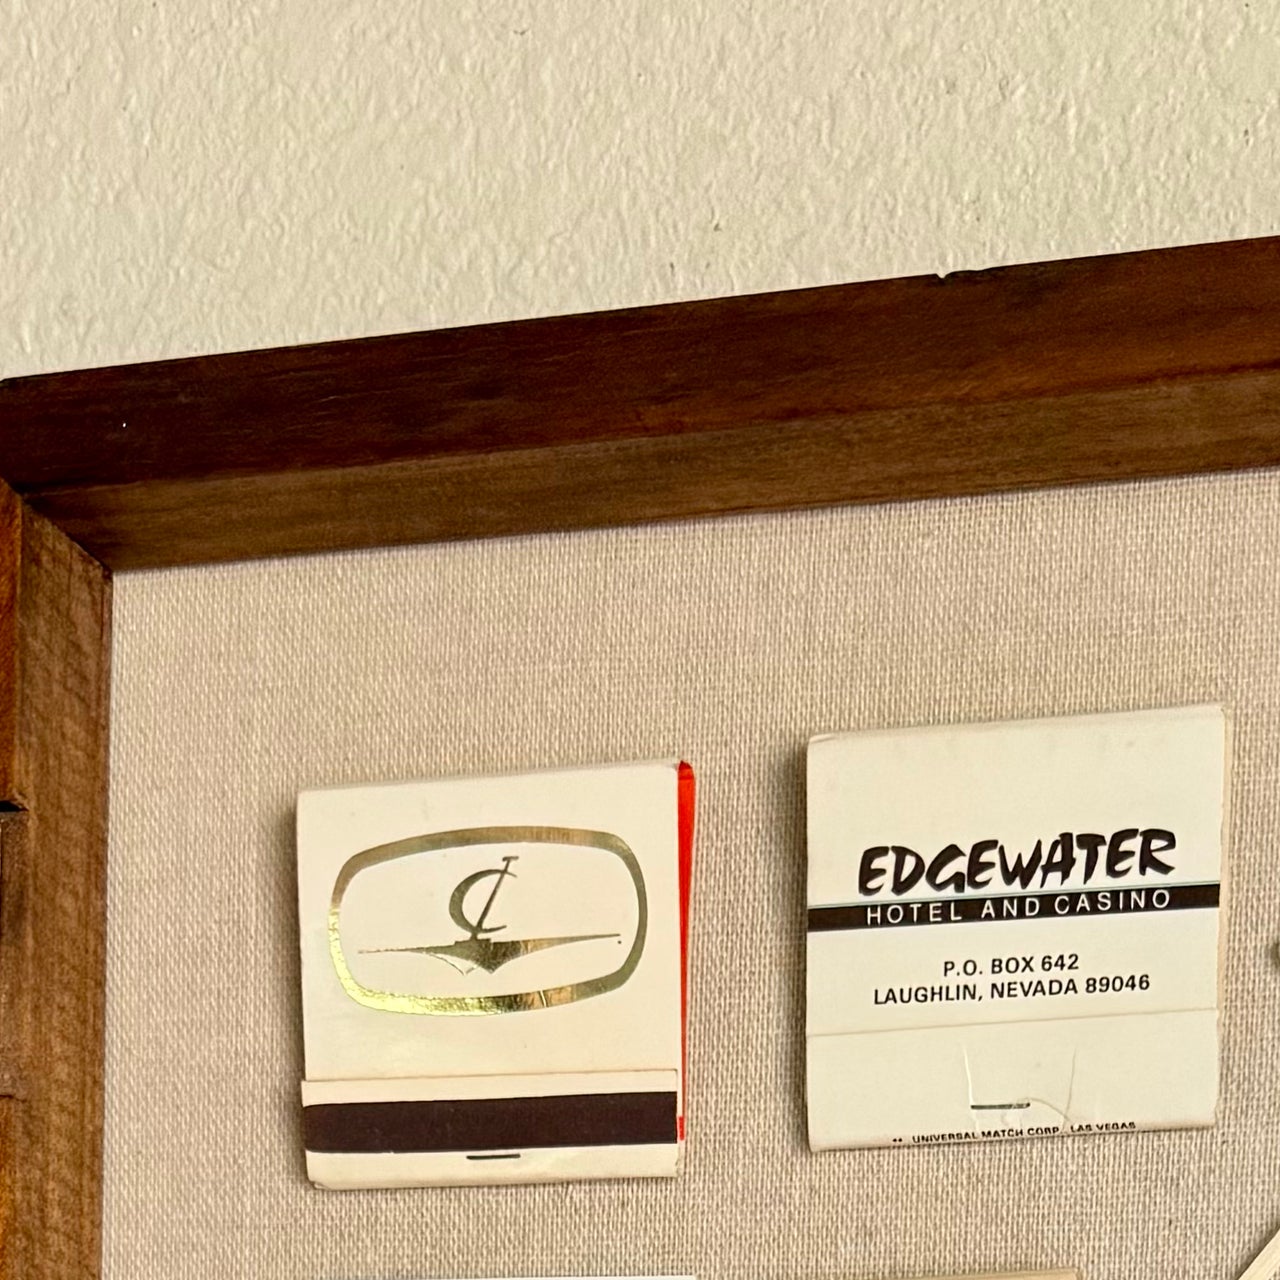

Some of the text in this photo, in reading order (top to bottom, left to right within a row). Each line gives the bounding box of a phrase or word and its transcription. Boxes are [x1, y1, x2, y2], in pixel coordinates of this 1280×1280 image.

[858, 829, 1176, 896] EDGEWATER
[867, 890, 1171, 925] HOTEL AND CASINO
[943, 955, 1079, 977] P.O. BOX 642
[874, 975, 1150, 1005] LAUGHLIN, NEVADA 89046
[912, 1132, 978, 1143] UNIVERSAL
[981, 1128, 1024, 1139] MATCH
